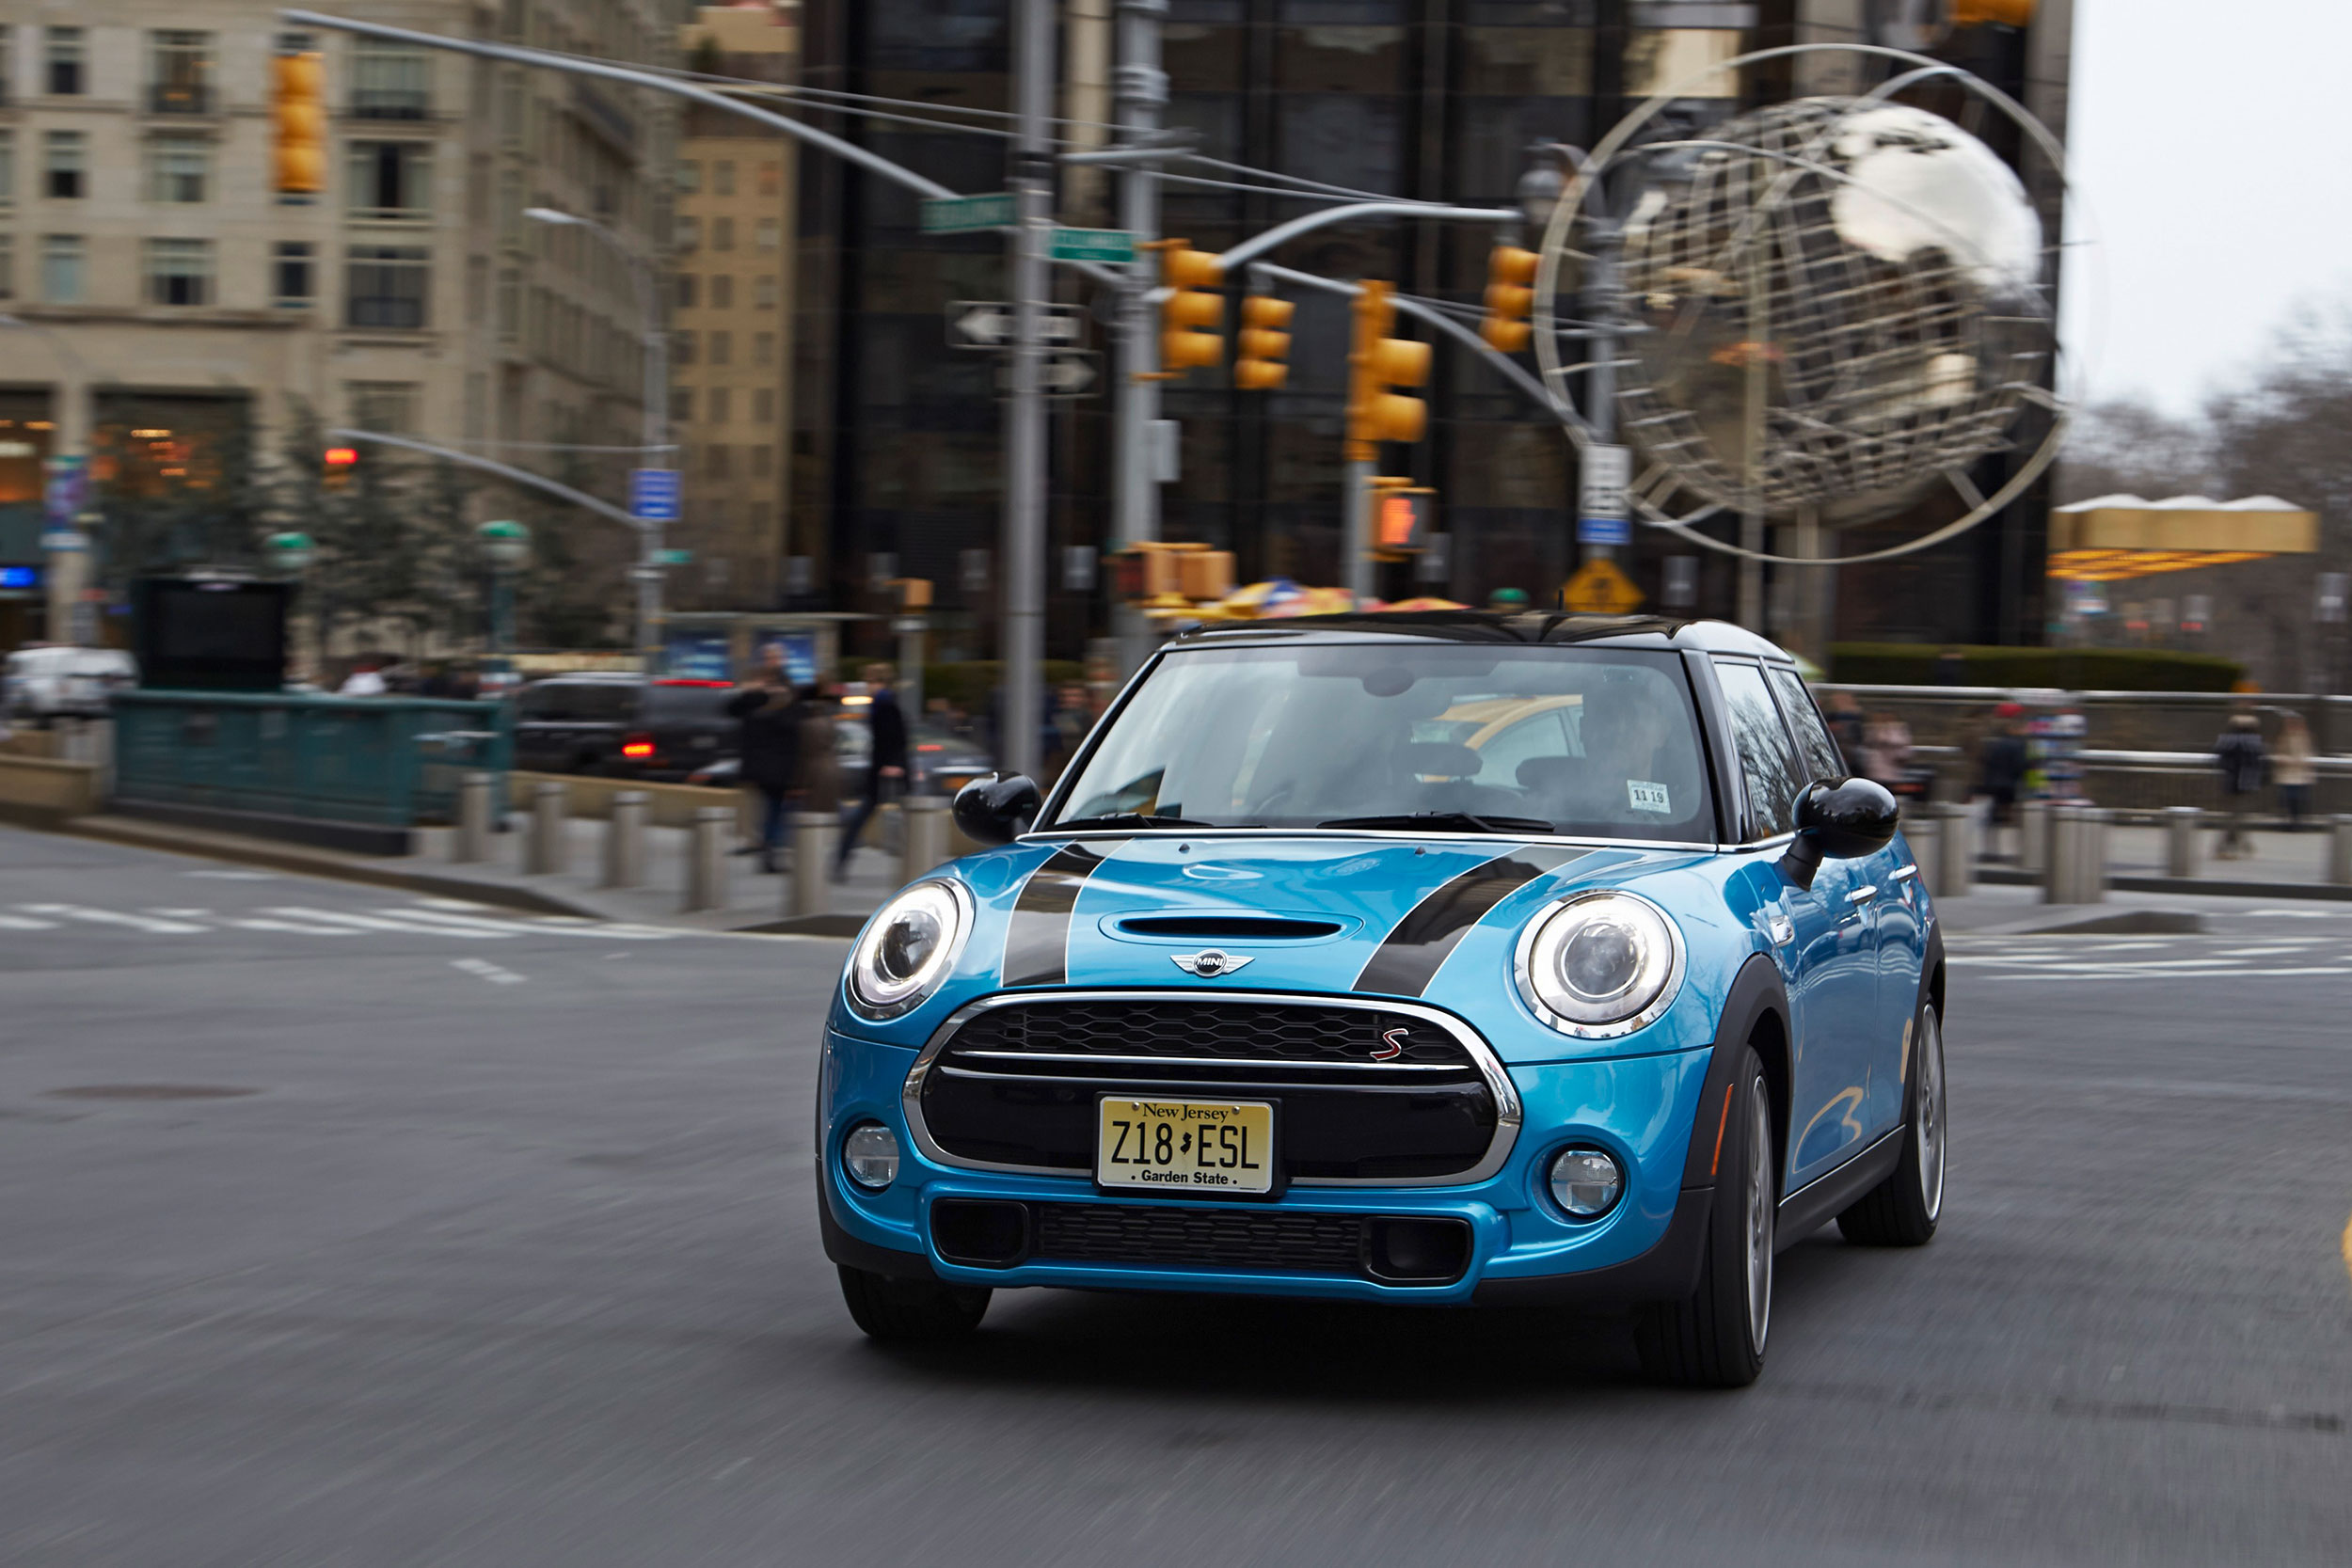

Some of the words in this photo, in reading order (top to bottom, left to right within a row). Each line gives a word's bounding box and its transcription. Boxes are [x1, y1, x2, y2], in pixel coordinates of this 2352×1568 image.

[1633, 789, 1648, 801] 11
[1197, 957, 1224, 967] MINI
[1369, 1027, 1409, 1061] S
[1142, 1102, 1180, 1118] New
[1180, 1103, 1230, 1123] Jersey
[1140, 1169, 1189, 1184] Garden
[1192, 1171, 1230, 1185] State
